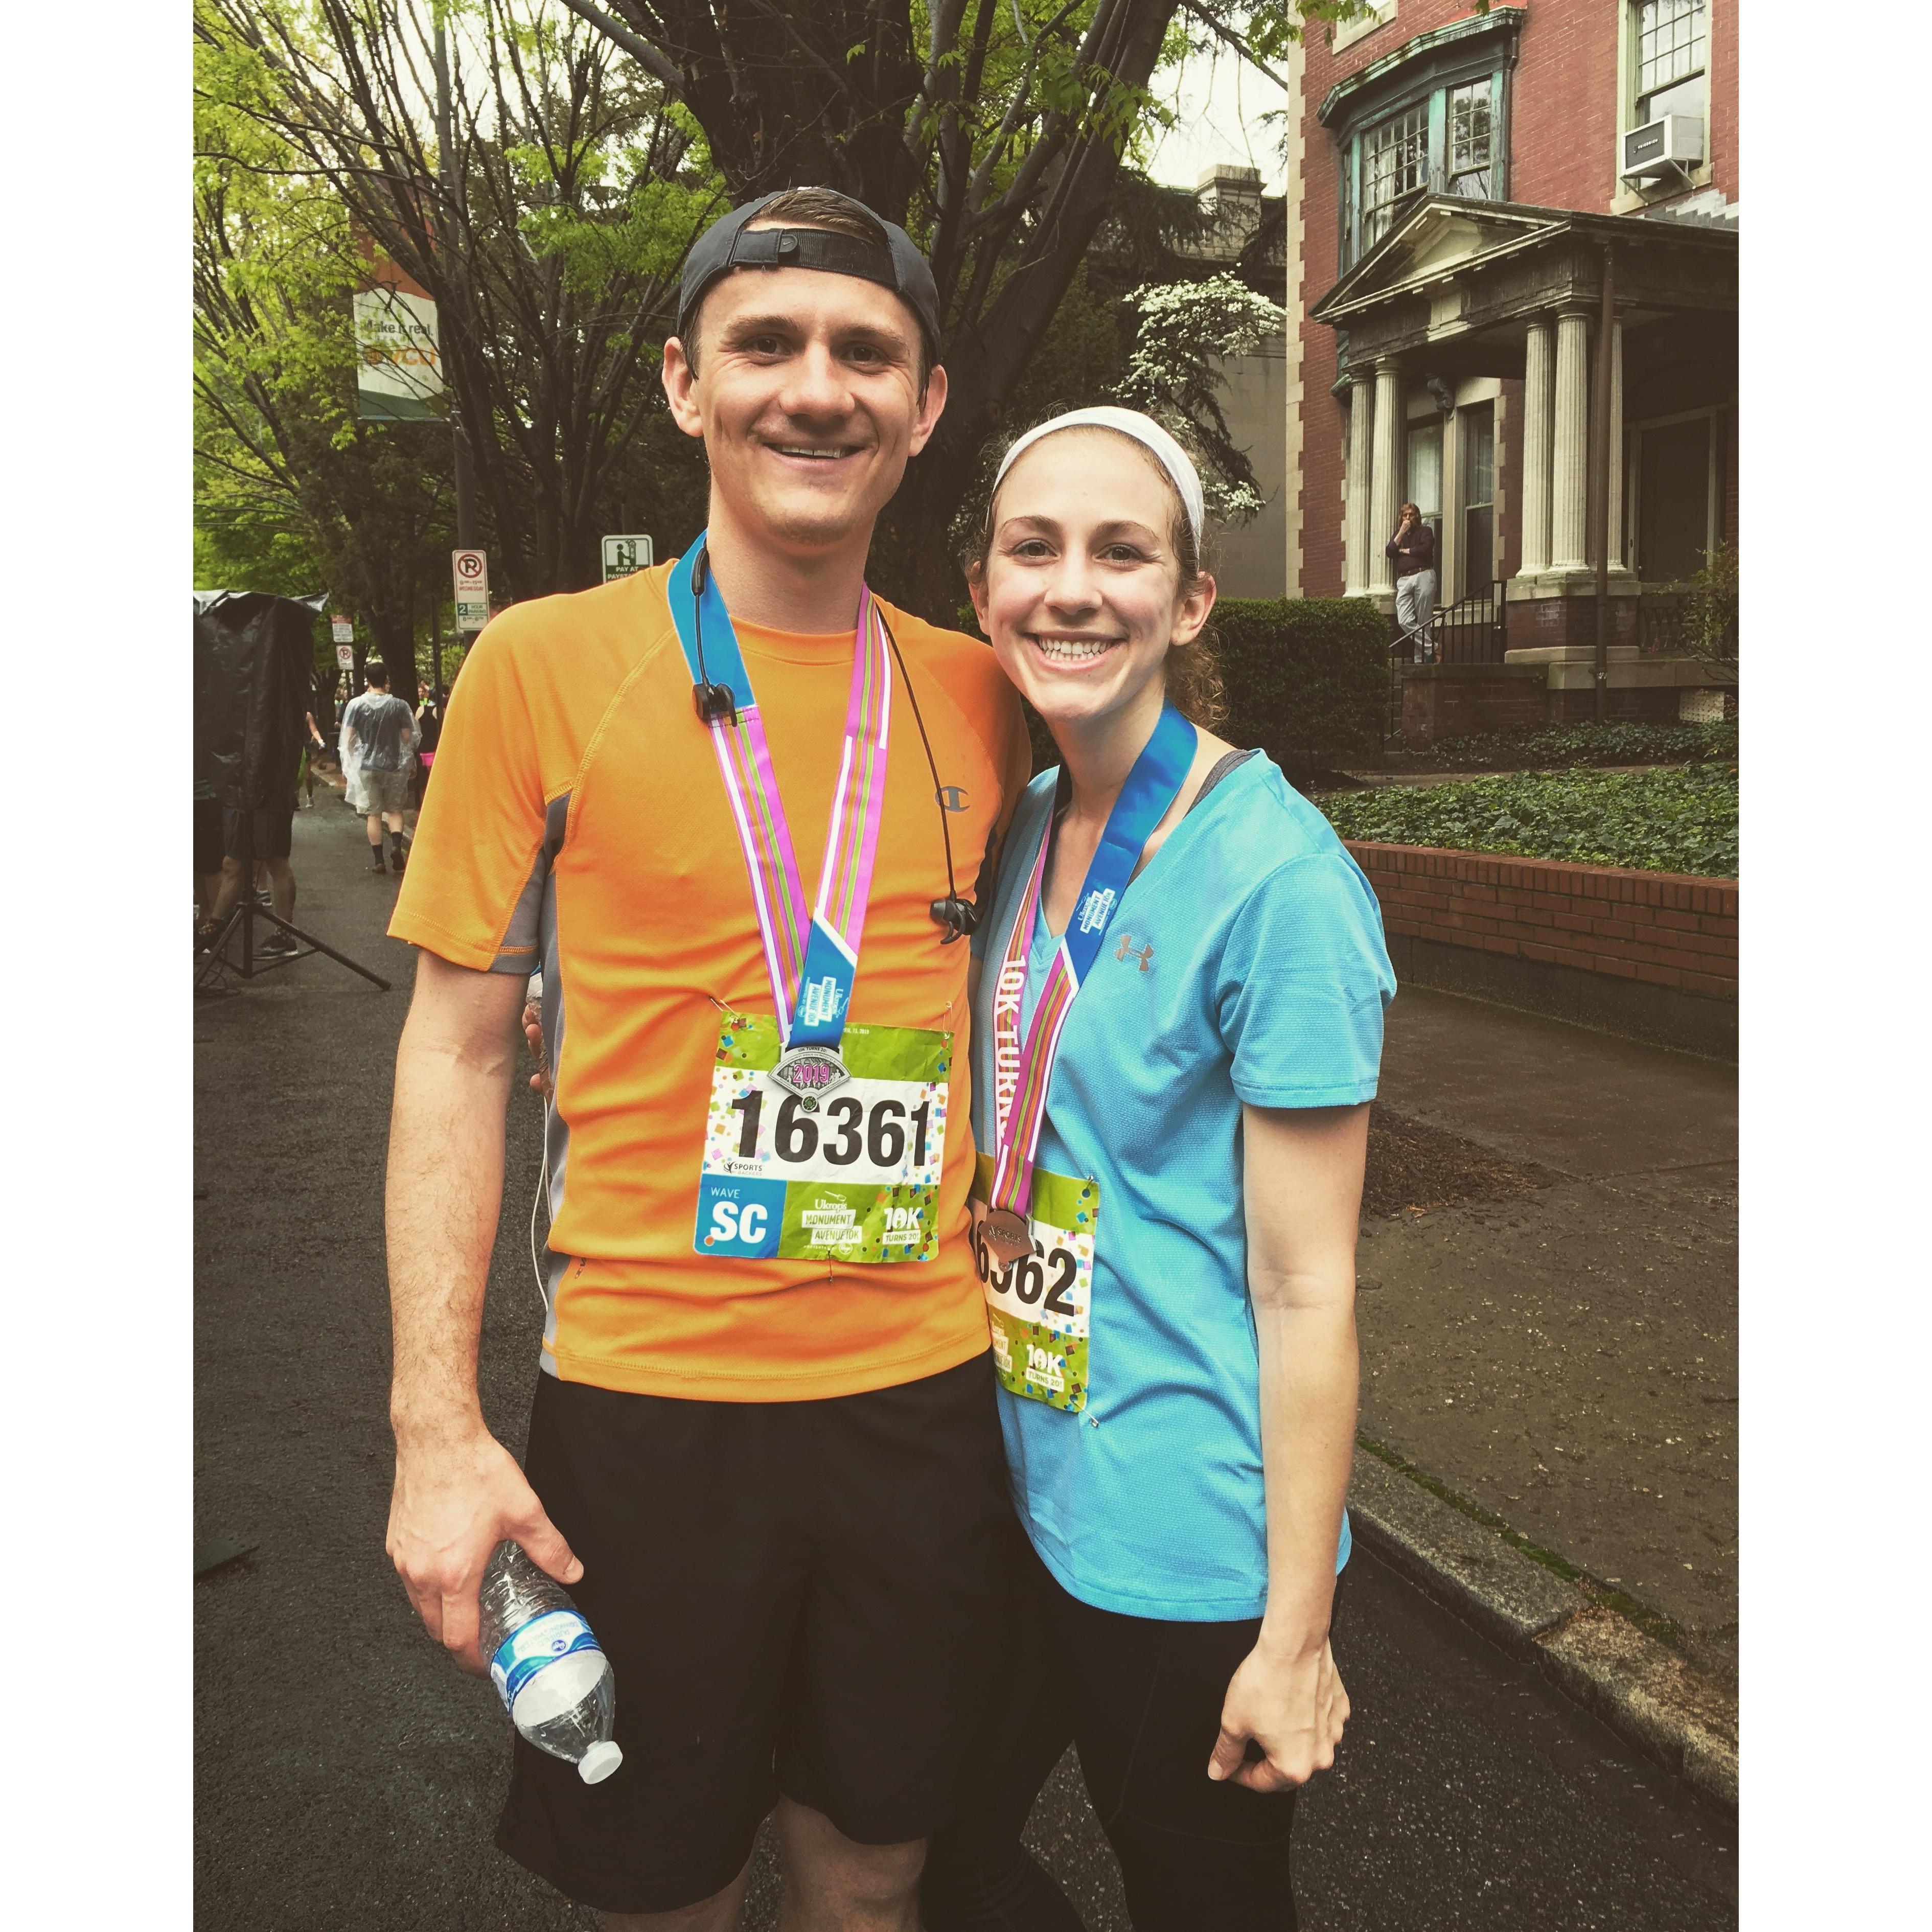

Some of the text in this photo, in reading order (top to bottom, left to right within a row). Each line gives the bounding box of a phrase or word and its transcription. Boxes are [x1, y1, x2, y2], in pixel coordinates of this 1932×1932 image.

[459, 605, 466, 613] 2
[1083, 895, 1100, 930] MONUMENT
[1095, 902, 1108, 926] AVENUE
[998, 955, 1026, 1015] 10K
[809, 986, 820, 1011] AVENUE
[821, 980, 833, 1017] MONUMENT
[793, 1064, 830, 1083] 2019
[731, 1090, 930, 1166] 16361
[734, 1163, 763, 1171] SPORTS
[711, 1186, 741, 1199] WAVE
[710, 1201, 768, 1244] SC
[806, 1214, 852, 1225] MONUMENT
[884, 1207, 922, 1230] 10K
[815, 1229, 859, 1240] AVENUE 10K
[886, 1234, 907, 1243] TURNS
[998, 1228, 1022, 1243] SPORTS
[1027, 1345, 1064, 1377] 10K
[1029, 1371, 1062, 1388] TURNS 20!
